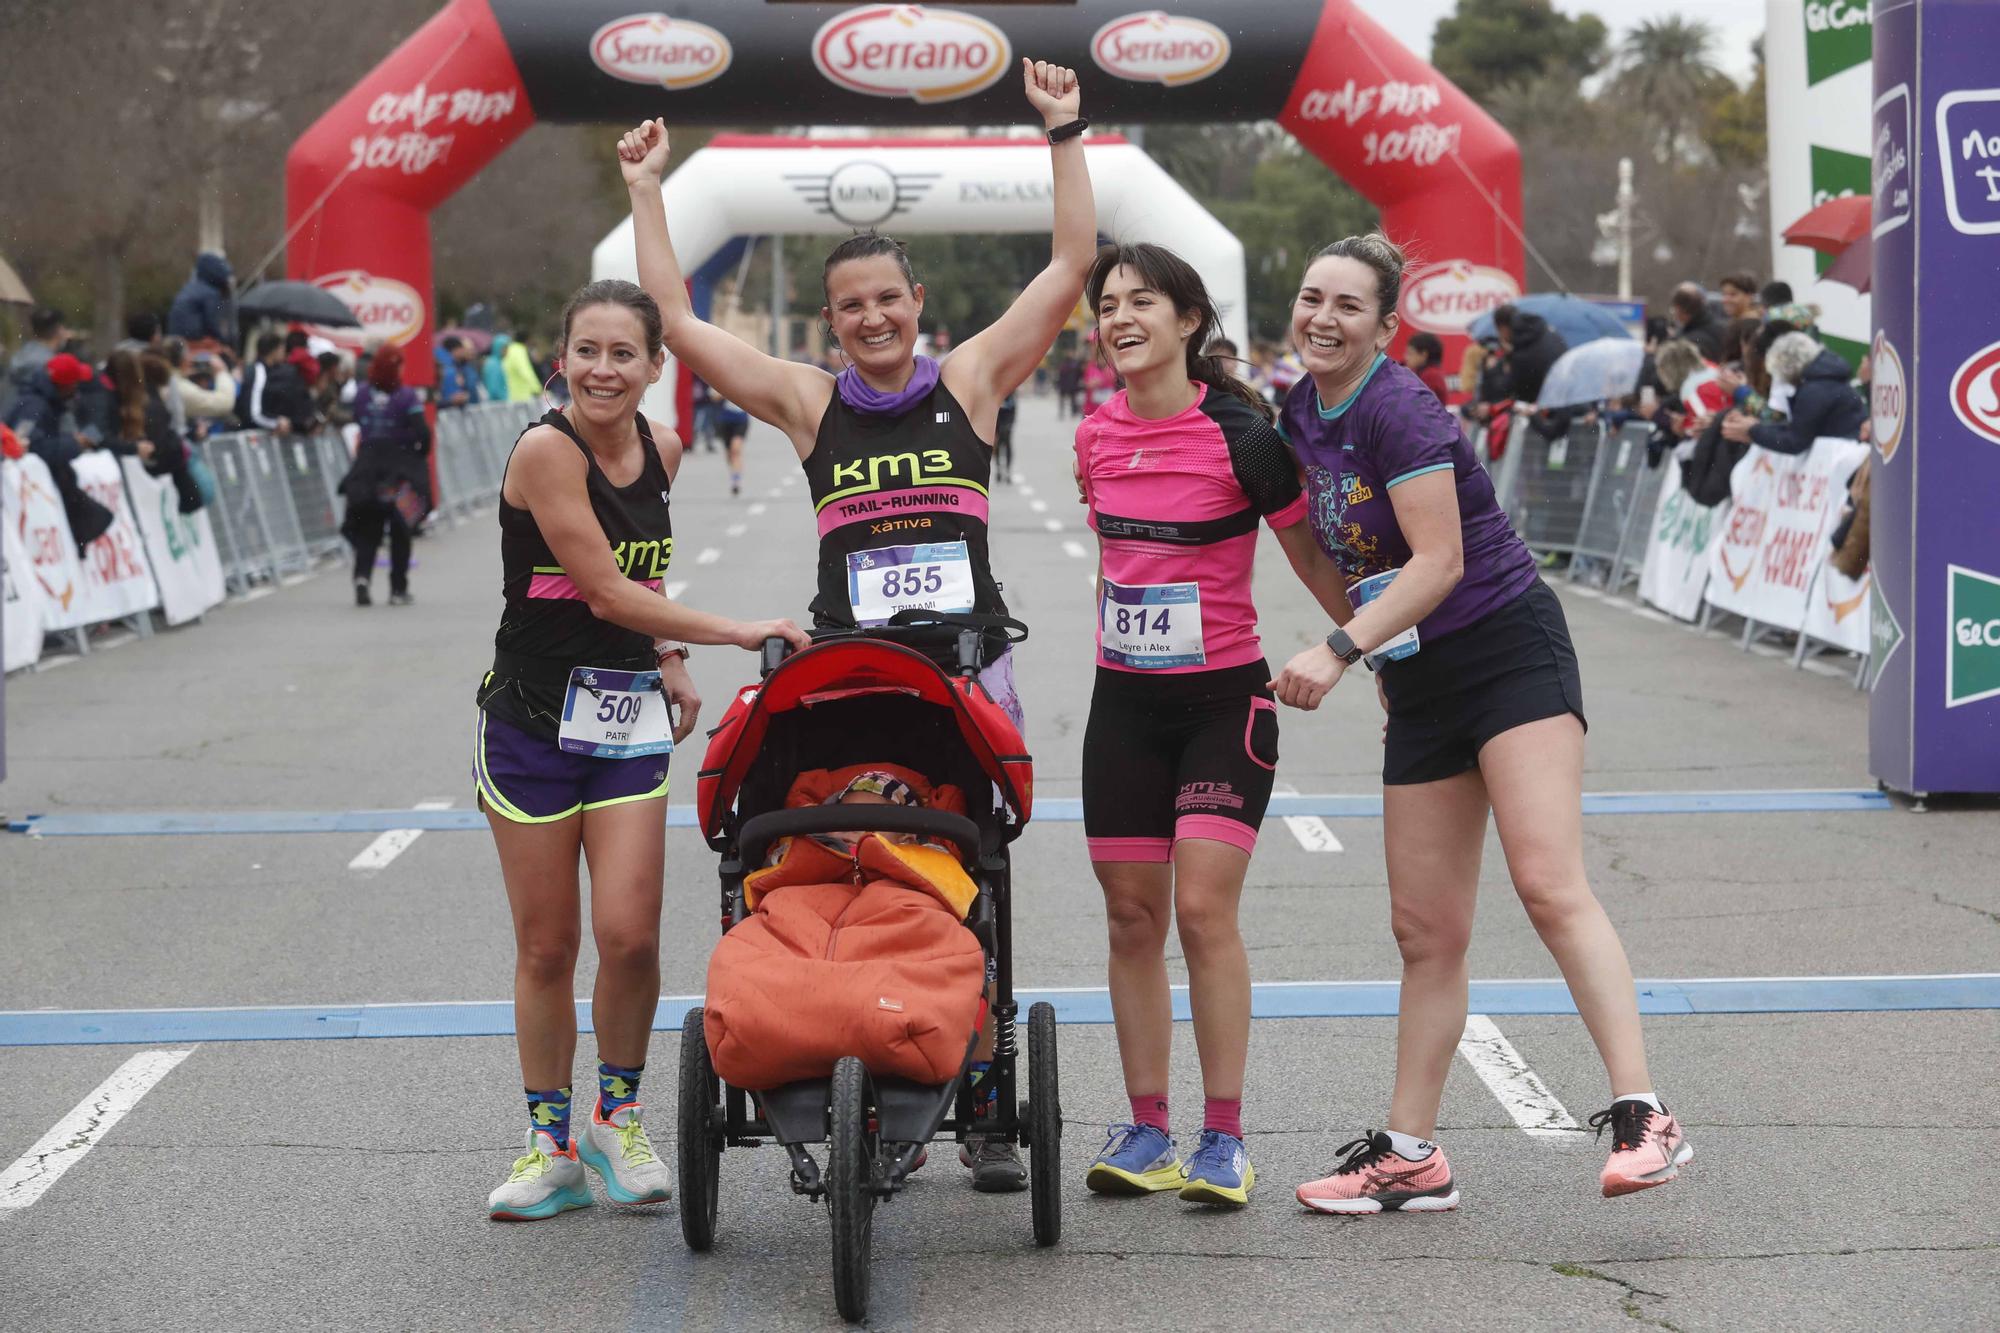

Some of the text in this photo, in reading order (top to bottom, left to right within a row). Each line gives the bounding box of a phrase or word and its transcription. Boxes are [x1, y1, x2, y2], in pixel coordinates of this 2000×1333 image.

[610, 34, 717, 65] Serrano
[838, 31, 989, 70] Serrano
[1109, 33, 1215, 61] Serrano
[353, 303, 415, 325] rano
[839, 493, 960, 519] TRAIL-RUNNING
[1350, 488, 1370, 503] FEM
[882, 565, 943, 598] 855
[1116, 608, 1171, 635] 814
[1119, 641, 1142, 653] Leyre
[1149, 643, 1171, 652] Alex
[596, 695, 642, 724] 509
